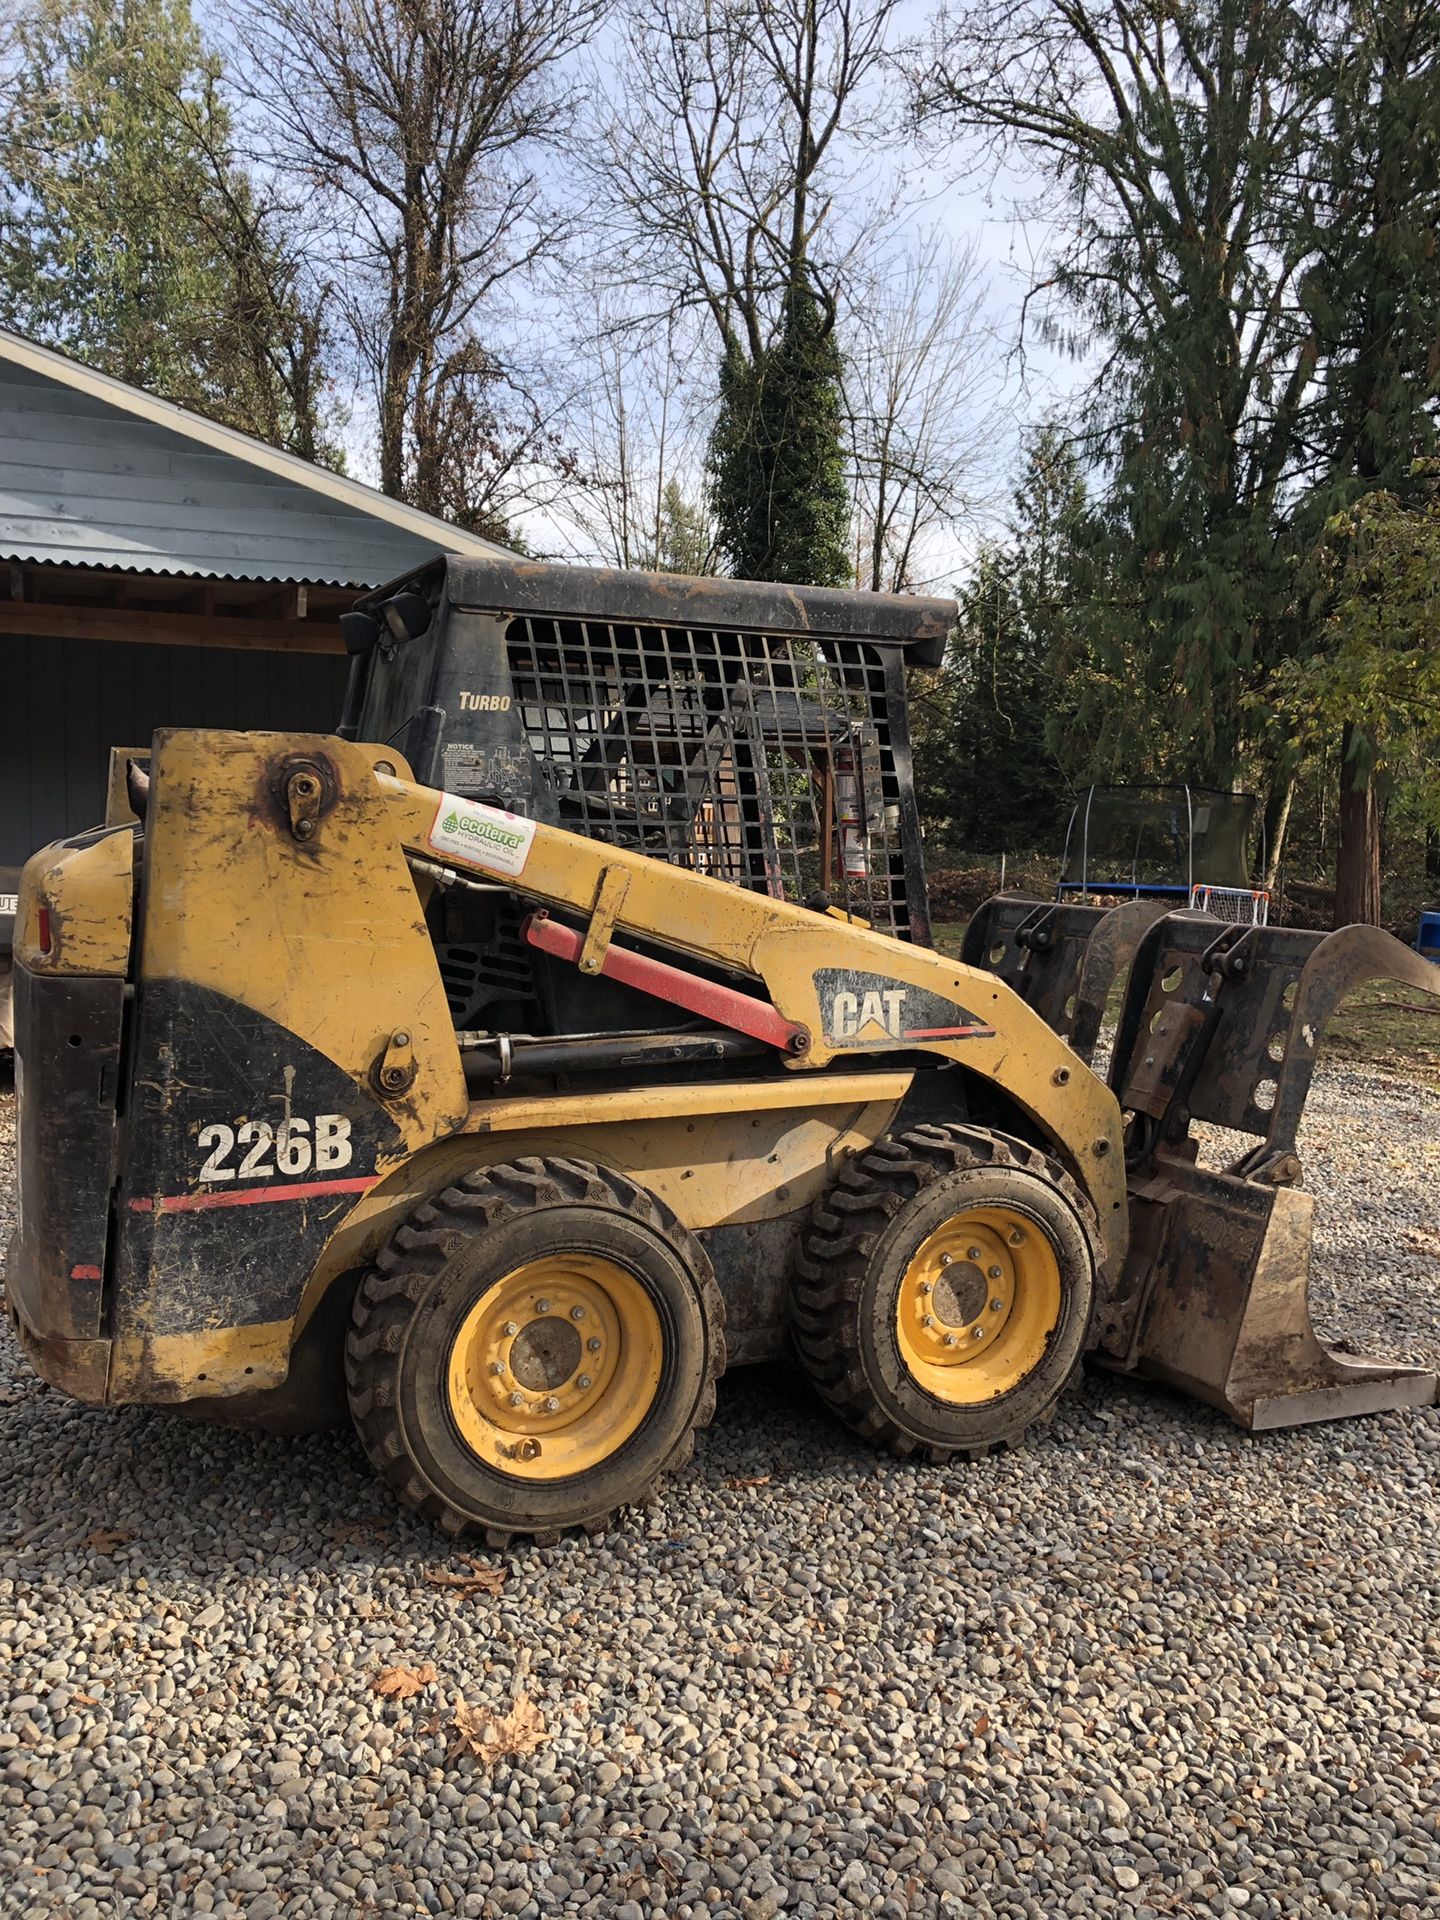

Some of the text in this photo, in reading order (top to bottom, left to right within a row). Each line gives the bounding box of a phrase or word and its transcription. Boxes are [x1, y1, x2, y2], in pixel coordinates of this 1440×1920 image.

[460, 691, 511, 711] TURBO
[457, 830, 515, 856] HYDRAULIC OIL
[833, 989, 906, 1039] CAT
[198, 1114, 353, 1182] 226B
